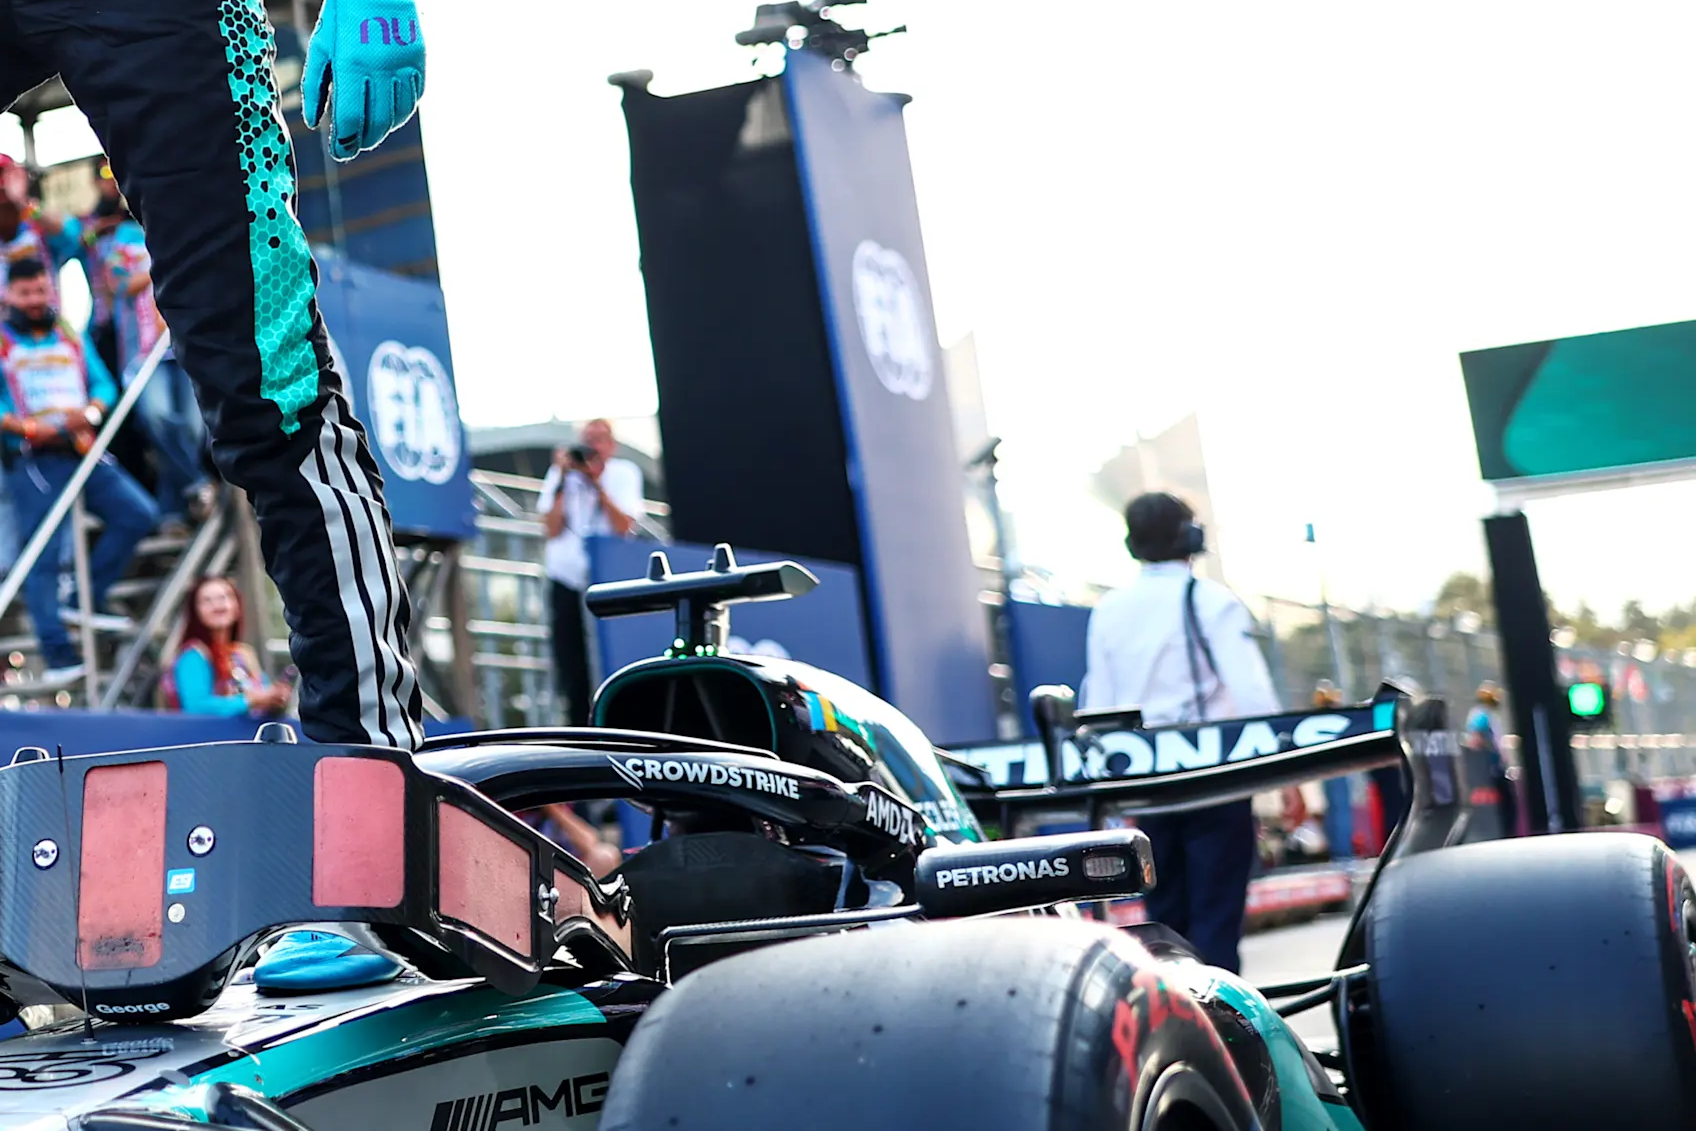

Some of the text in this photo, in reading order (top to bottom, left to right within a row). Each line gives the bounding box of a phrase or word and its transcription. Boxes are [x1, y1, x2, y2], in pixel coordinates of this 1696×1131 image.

[623, 757, 800, 800] CROWDSTRIKE
[866, 790, 901, 837] AMD
[936, 857, 1070, 888] PETRONAS
[95, 1000, 171, 1015] George
[488, 1071, 609, 1131] AMG
